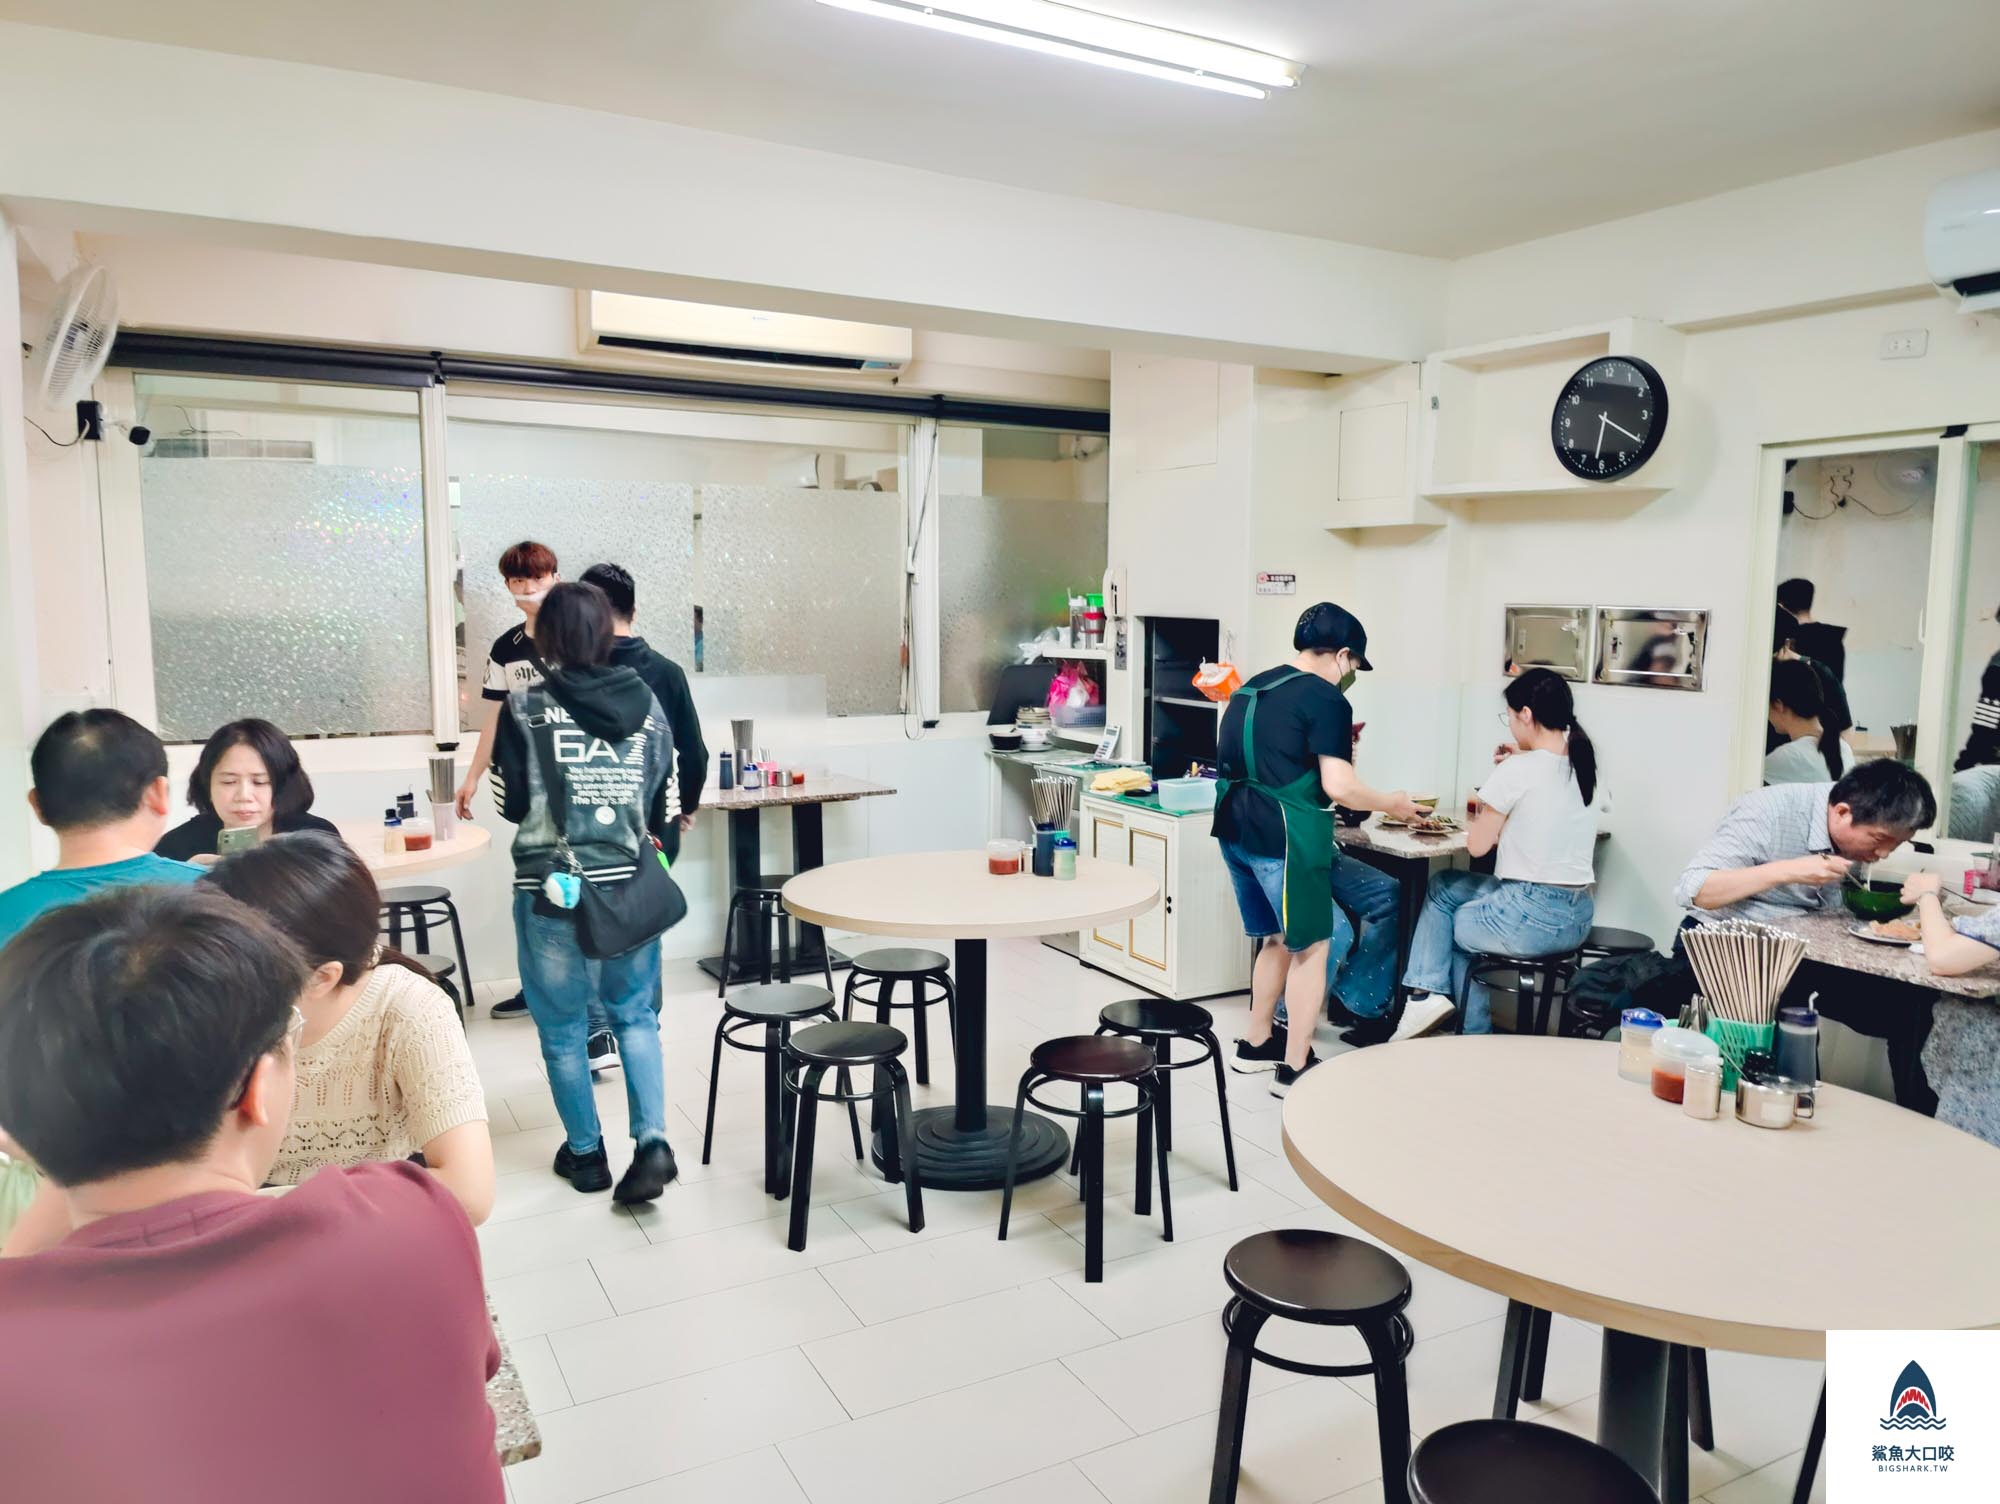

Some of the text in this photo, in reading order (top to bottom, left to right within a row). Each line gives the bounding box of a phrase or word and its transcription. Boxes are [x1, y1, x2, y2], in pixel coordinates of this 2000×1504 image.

[1605, 368, 1614, 378] 12
[1627, 373, 1632, 382] 1
[1586, 378, 1594, 387] 11
[1638, 387, 1644, 398] 2
[1571, 394, 1580, 405] 10
[1641, 410, 1648, 420] 3
[1565, 418, 1571, 427] 9
[1568, 438, 1574, 448] 8
[1581, 454, 1587, 463] 7
[1619, 452, 1625, 462] 5
[1599, 460, 1605, 470] 6
